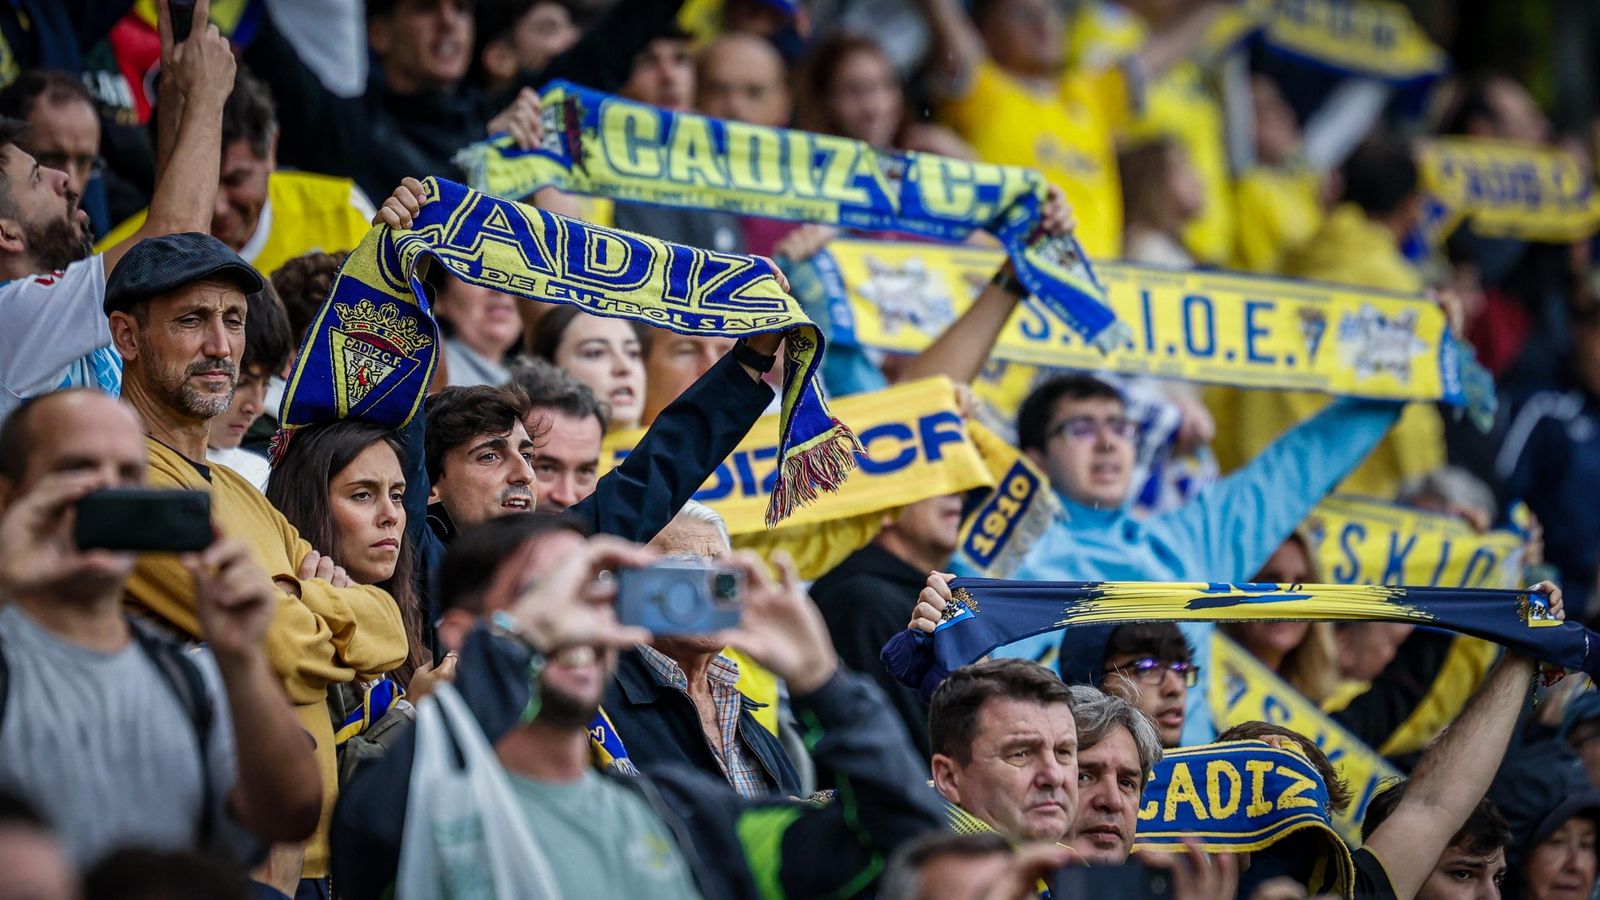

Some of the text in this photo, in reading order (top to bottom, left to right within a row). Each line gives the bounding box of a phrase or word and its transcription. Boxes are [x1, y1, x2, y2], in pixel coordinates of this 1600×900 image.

[601, 98, 871, 206] CADIZ
[480, 266, 536, 291] DE
[344, 337, 380, 360] CADIZ
[853, 411, 964, 476] CF
[972, 474, 1031, 557] 1910
